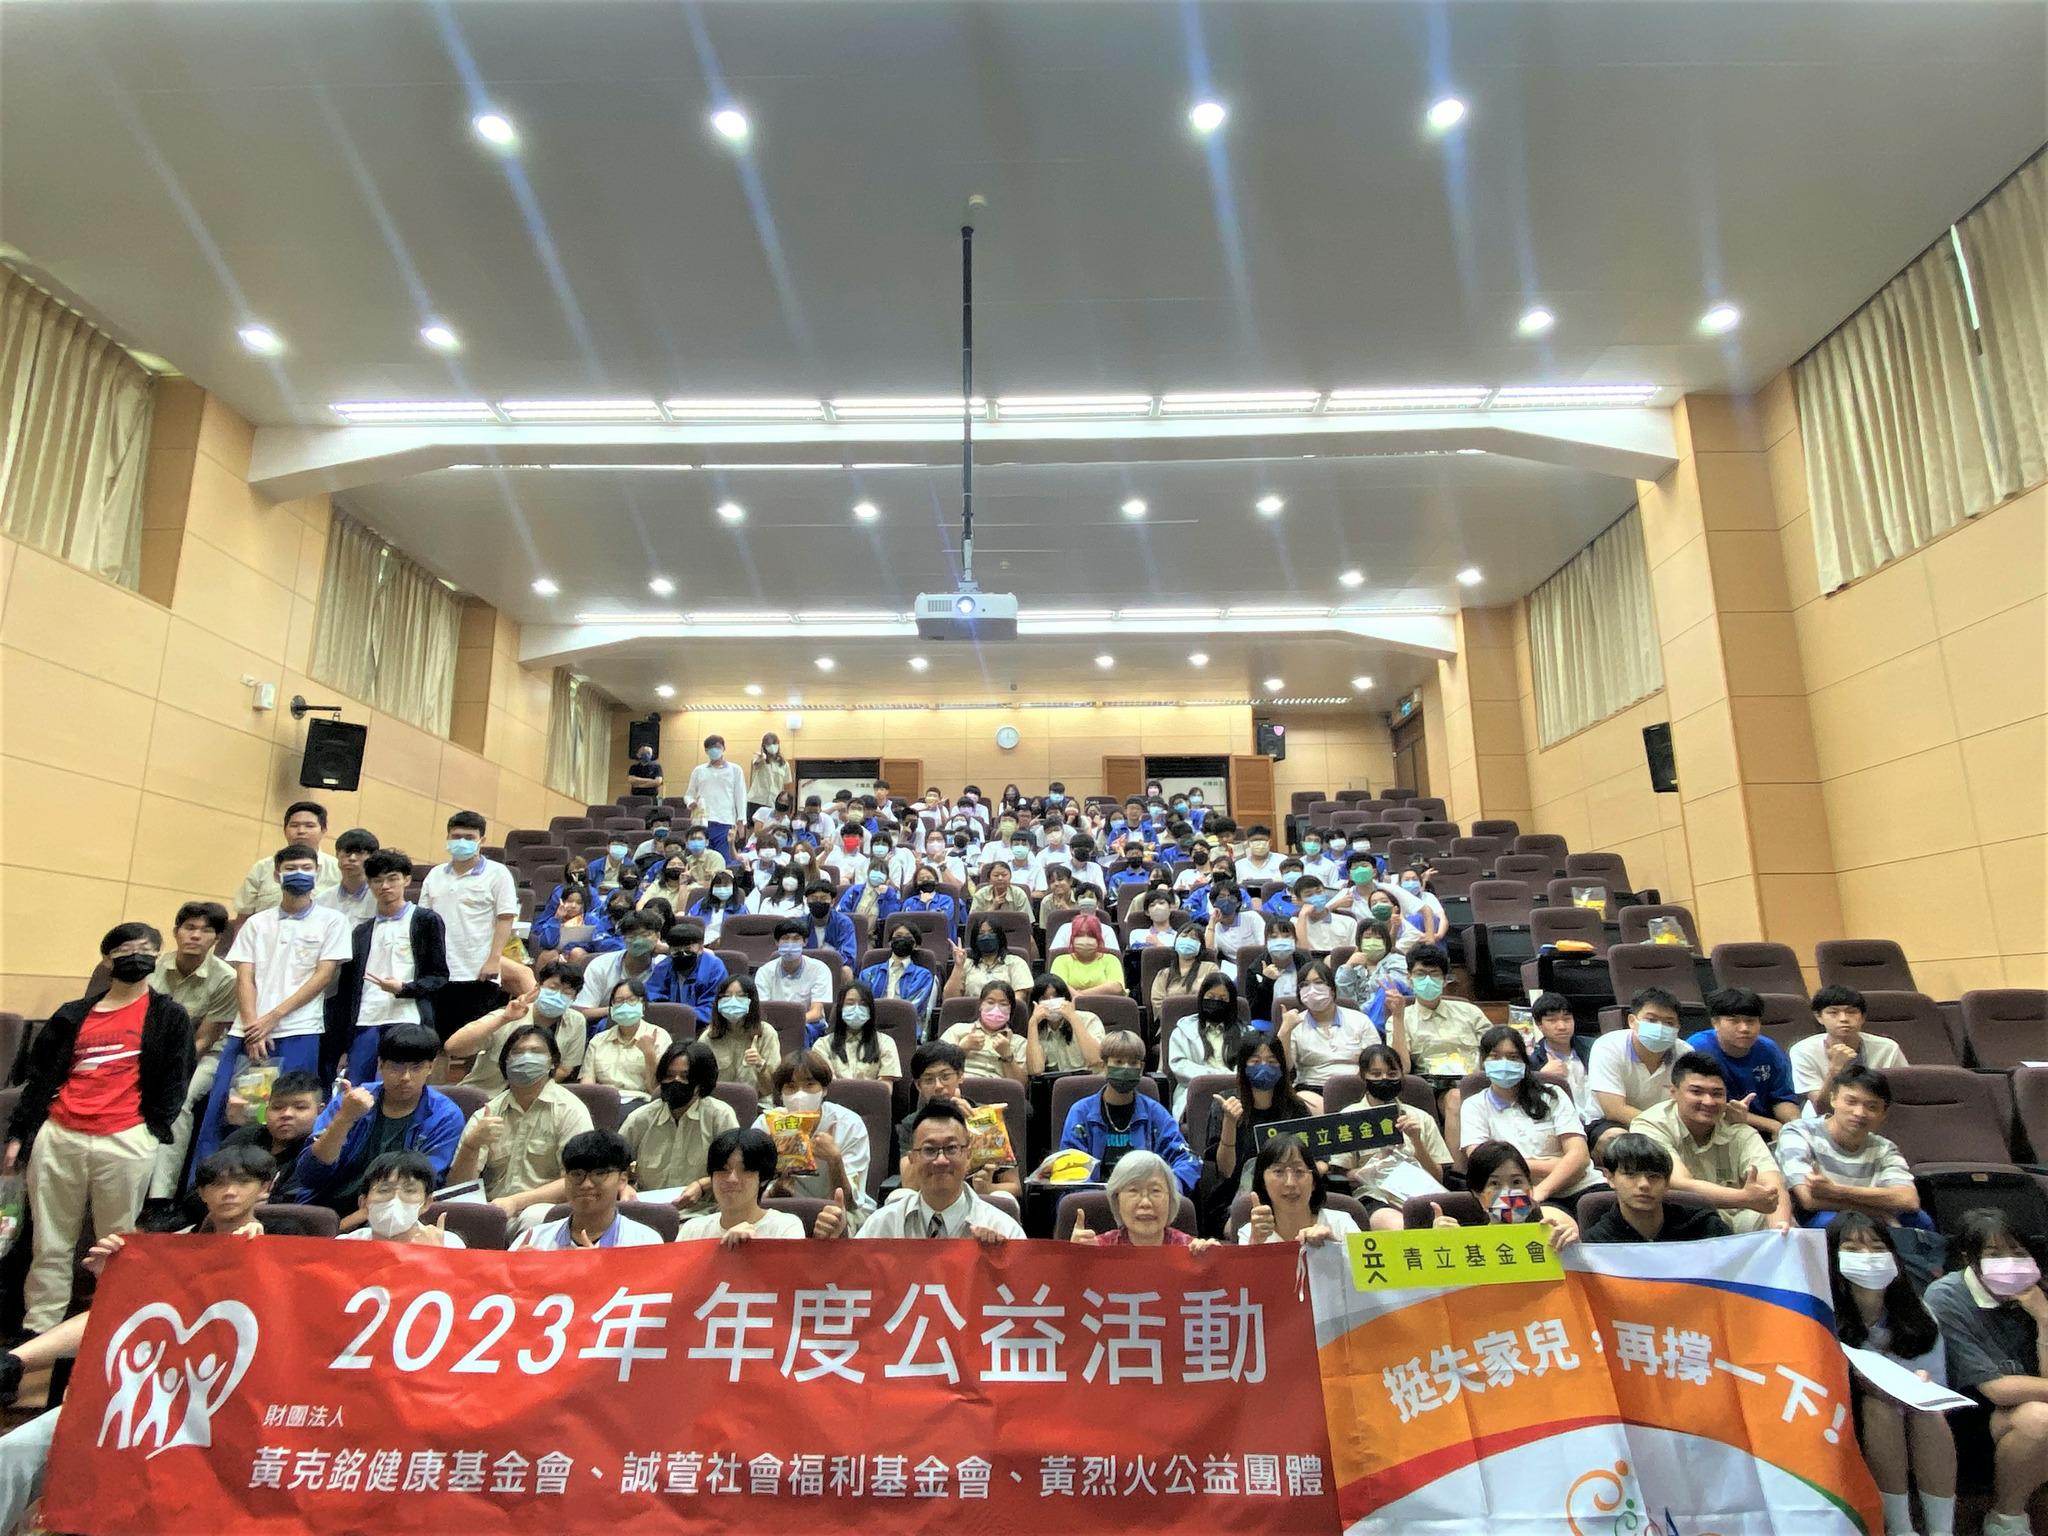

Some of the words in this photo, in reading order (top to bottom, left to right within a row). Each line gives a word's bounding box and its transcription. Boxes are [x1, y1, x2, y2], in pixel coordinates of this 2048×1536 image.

[1402, 1239, 1547, 1272] 青立基金會
[328, 1281, 1267, 1384] 2023年年度公益活動
[262, 1403, 345, 1428] 財團法人
